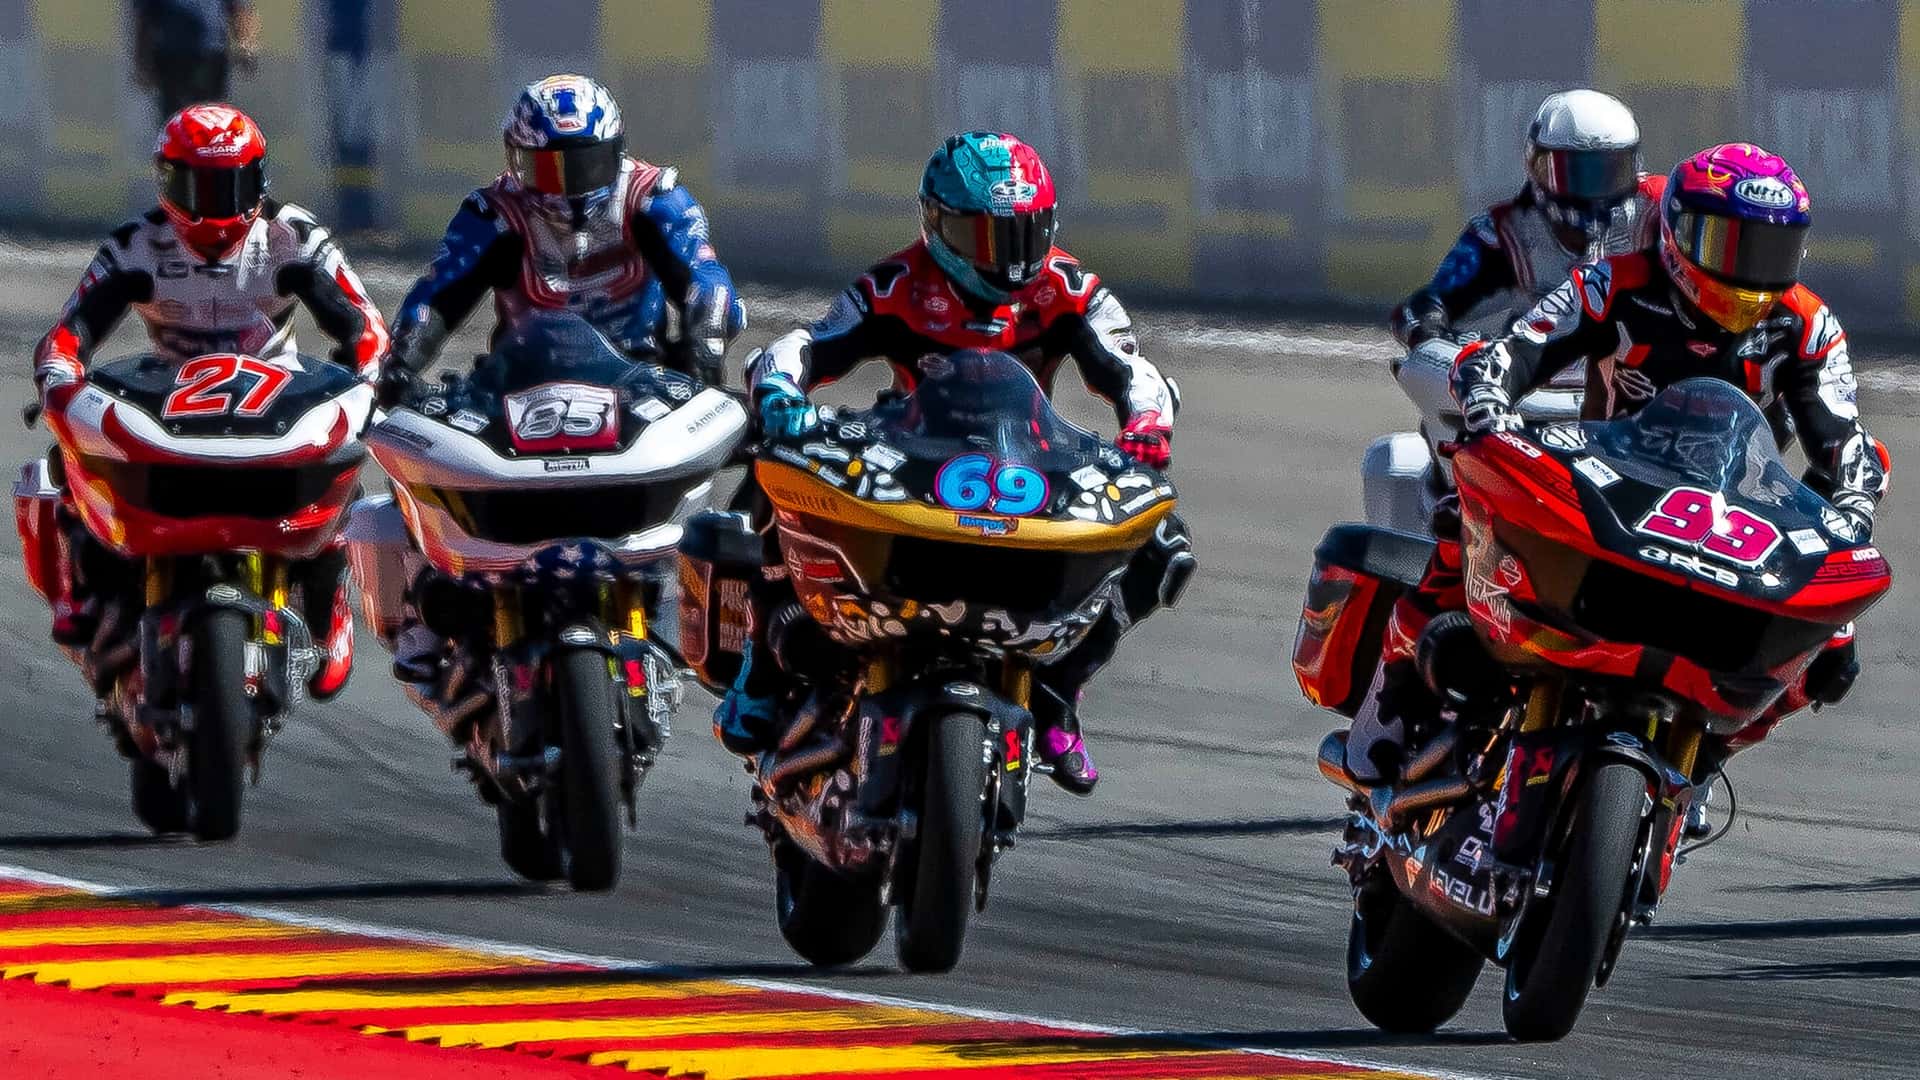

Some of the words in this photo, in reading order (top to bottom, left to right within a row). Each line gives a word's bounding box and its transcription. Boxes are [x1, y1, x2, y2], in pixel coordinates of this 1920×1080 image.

[161, 352, 295, 420] 27
[933, 451, 1051, 517] 69
[1634, 485, 1784, 570] 99
